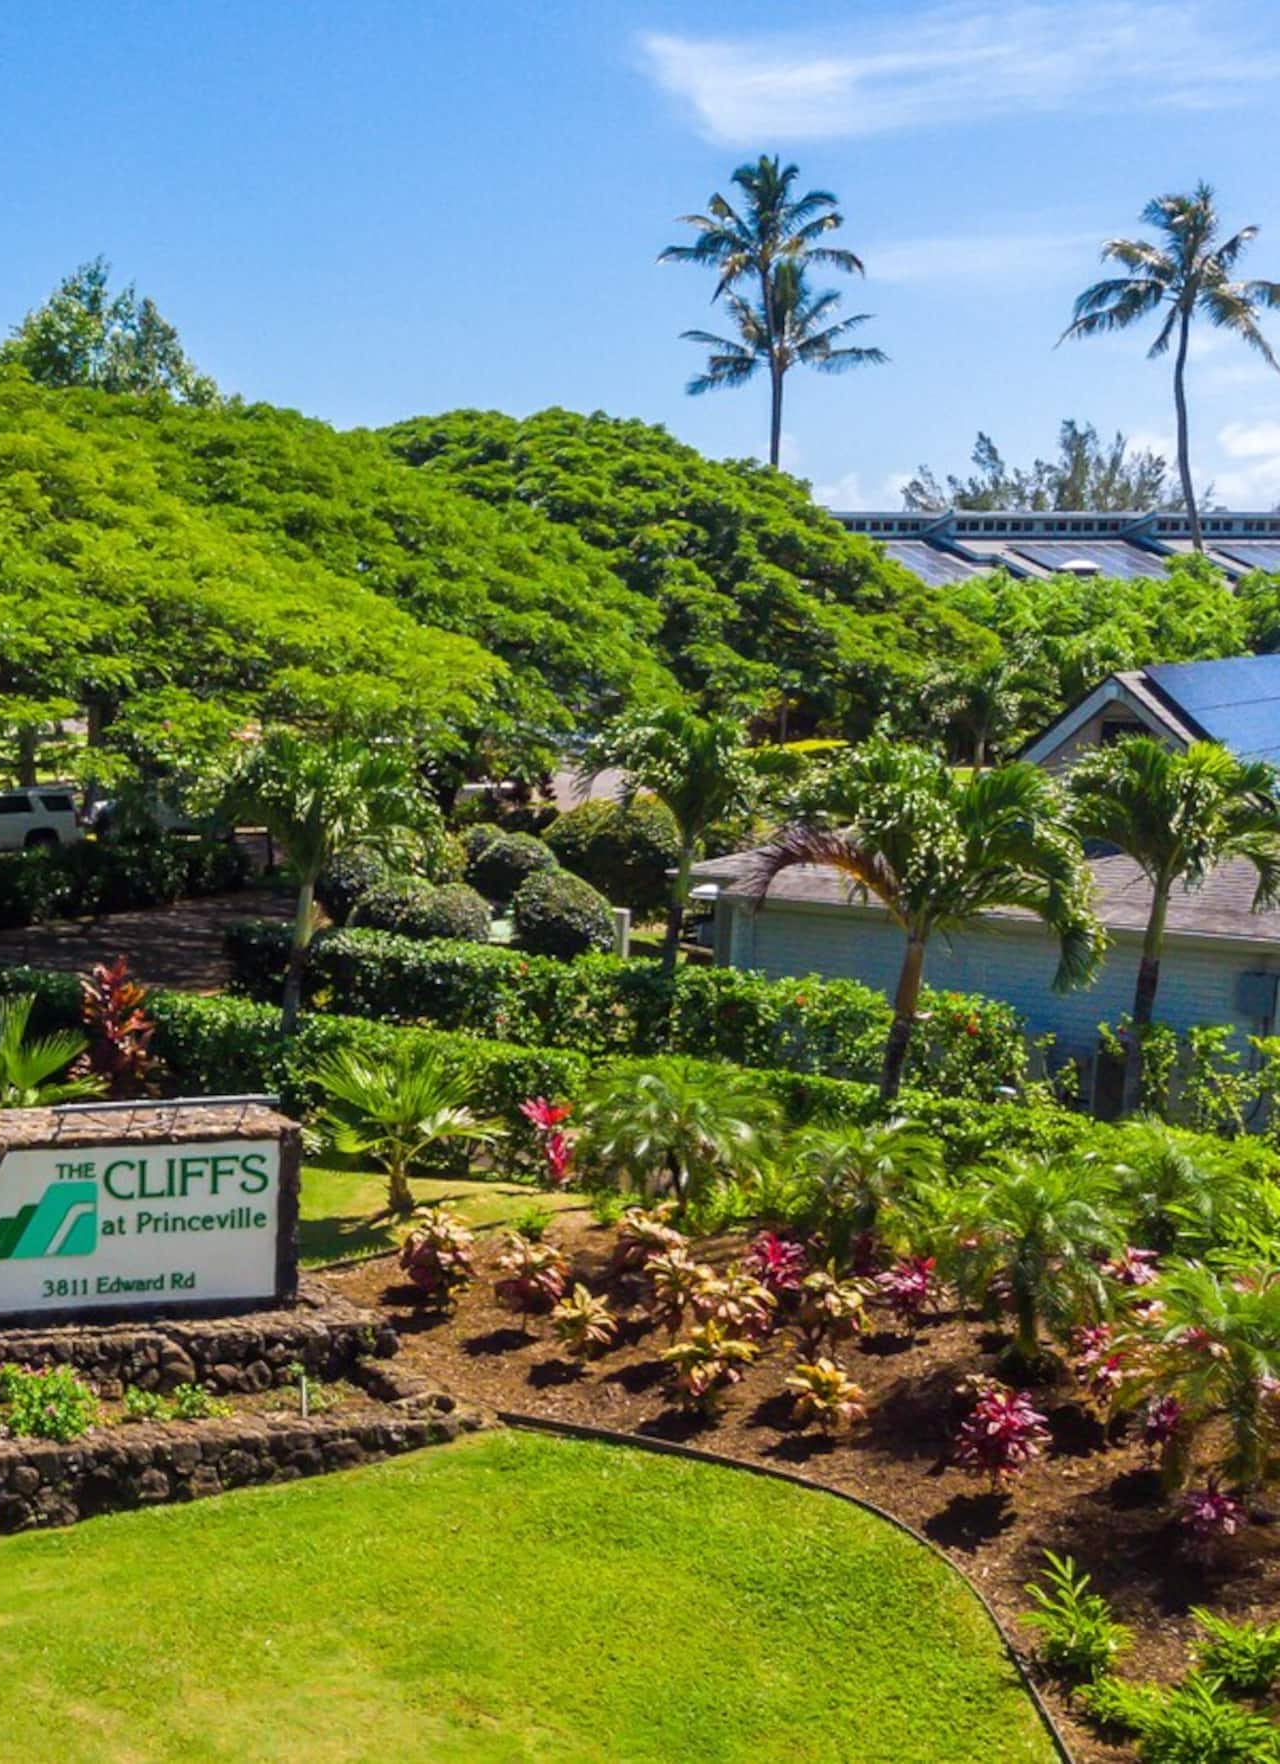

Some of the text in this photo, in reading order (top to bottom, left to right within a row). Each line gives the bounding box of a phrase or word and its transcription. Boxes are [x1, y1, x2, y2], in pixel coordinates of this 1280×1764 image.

[56, 1154, 269, 1200] THE CLIFFS
[101, 1207, 267, 1235] at Princeville
[42, 1272, 196, 1297] 3811 Edward Rd
